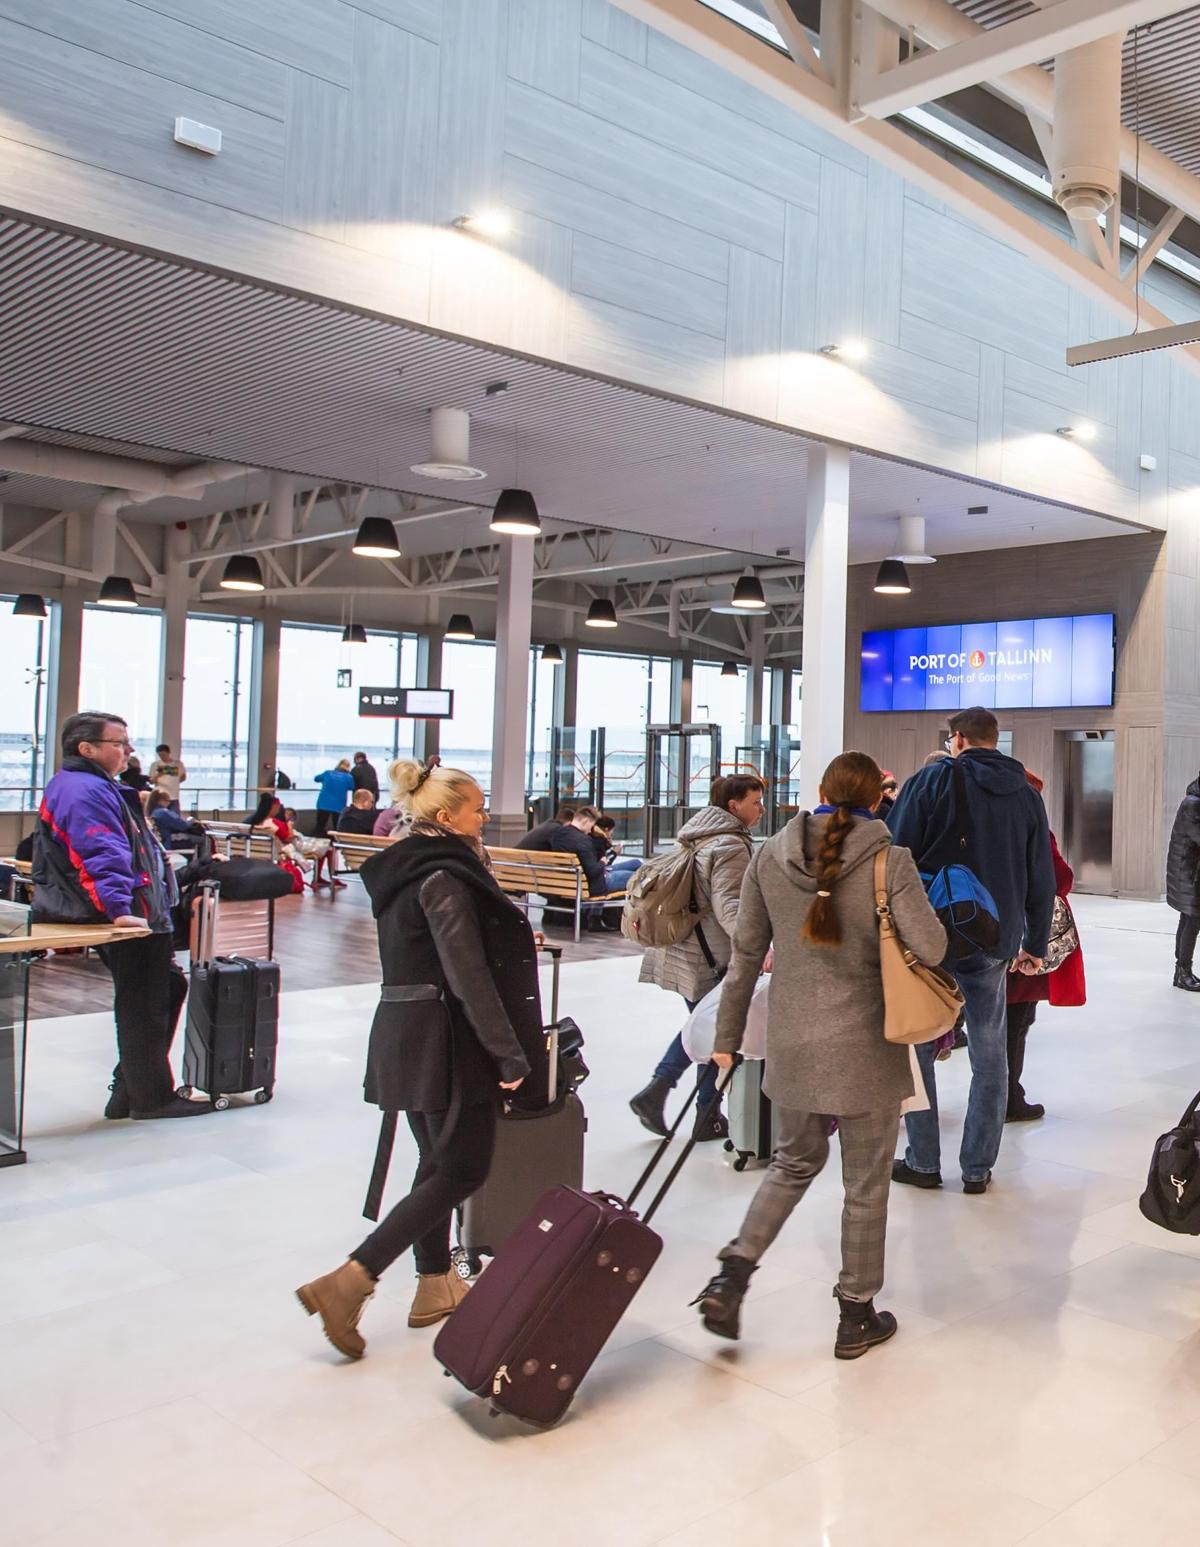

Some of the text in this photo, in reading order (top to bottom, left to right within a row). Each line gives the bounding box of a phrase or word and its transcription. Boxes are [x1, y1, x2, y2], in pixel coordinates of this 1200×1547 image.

[909, 648, 1052, 670] PORT OF TALLINN
[928, 671, 1030, 685] The Port of Good News
